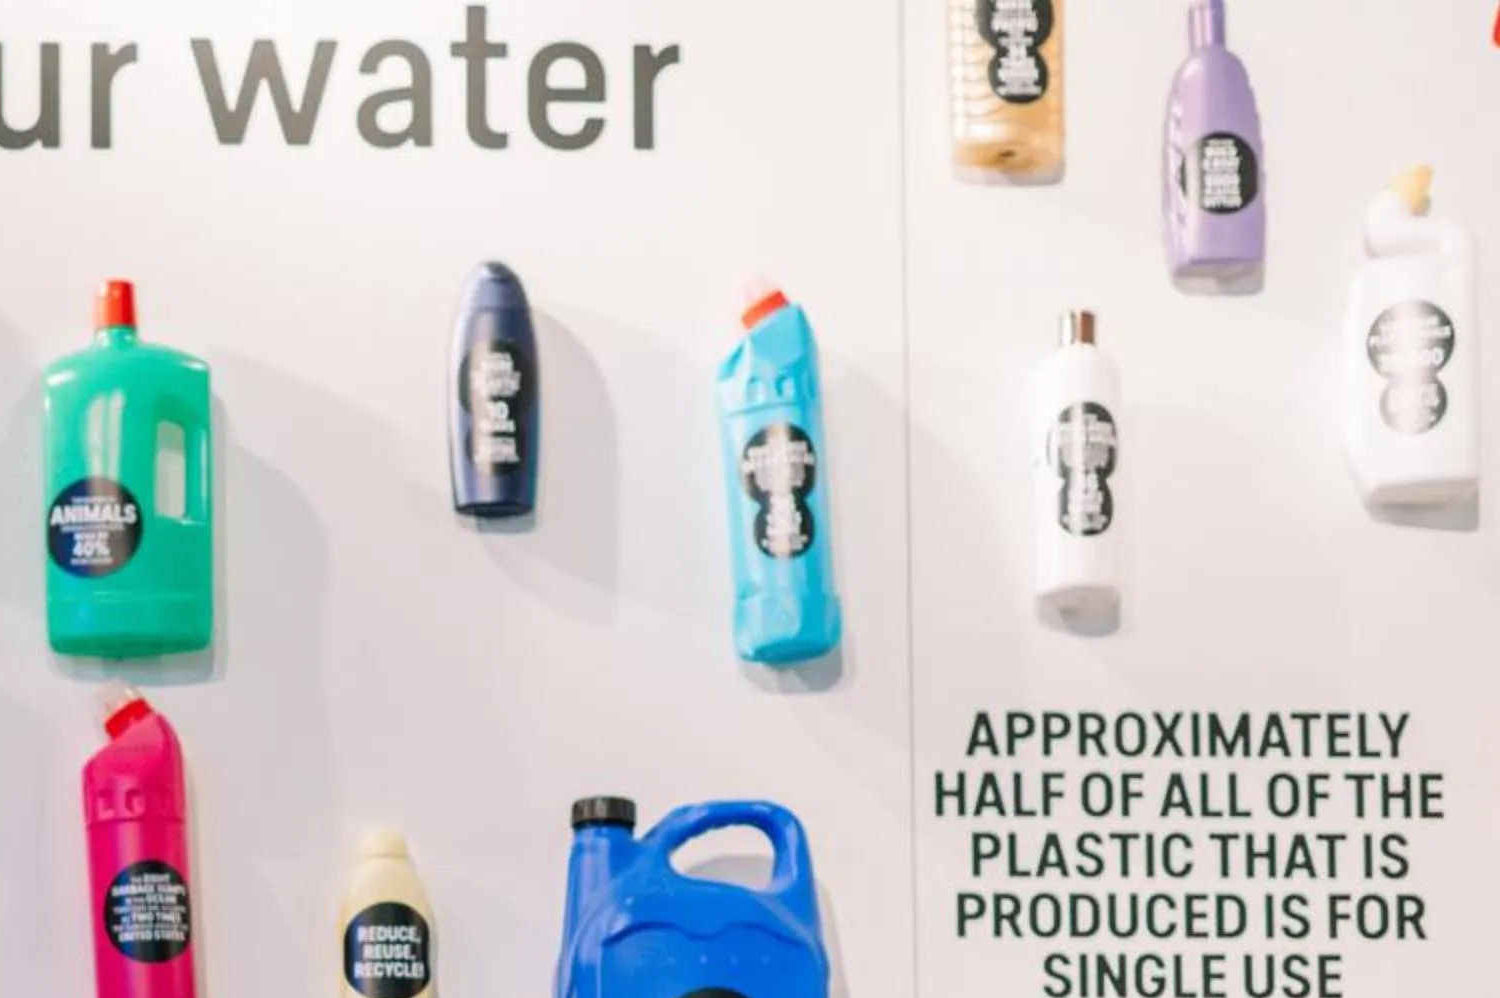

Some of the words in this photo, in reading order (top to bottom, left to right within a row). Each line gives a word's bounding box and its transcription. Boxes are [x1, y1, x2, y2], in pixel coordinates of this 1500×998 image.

[190, 5, 680, 150] water
[50, 505, 137, 525] ANIMALS
[967, 713, 1408, 757] APPROXIMATELY
[936, 772, 1063, 816] HALF
[1082, 773, 1142, 816] OF
[1161, 774, 1251, 816] ALL
[1269, 774, 1329, 817] OF
[1345, 774, 1443, 818] THE
[973, 833, 1192, 877] PLASTIC
[1210, 834, 1346, 877] THAT
[1365, 834, 1408, 878] IS
[358, 925, 421, 942] REDUCE,
[958, 894, 1246, 937] PRODUCED
[1266, 895, 1309, 938] IS
[1330, 895, 1425, 939] FOR
[353, 961, 425, 978] RECYCLE!
[364, 943, 418, 960] REUSE,
[1044, 954, 1225, 998] SINGLE
[1245, 955, 1341, 998] USE
